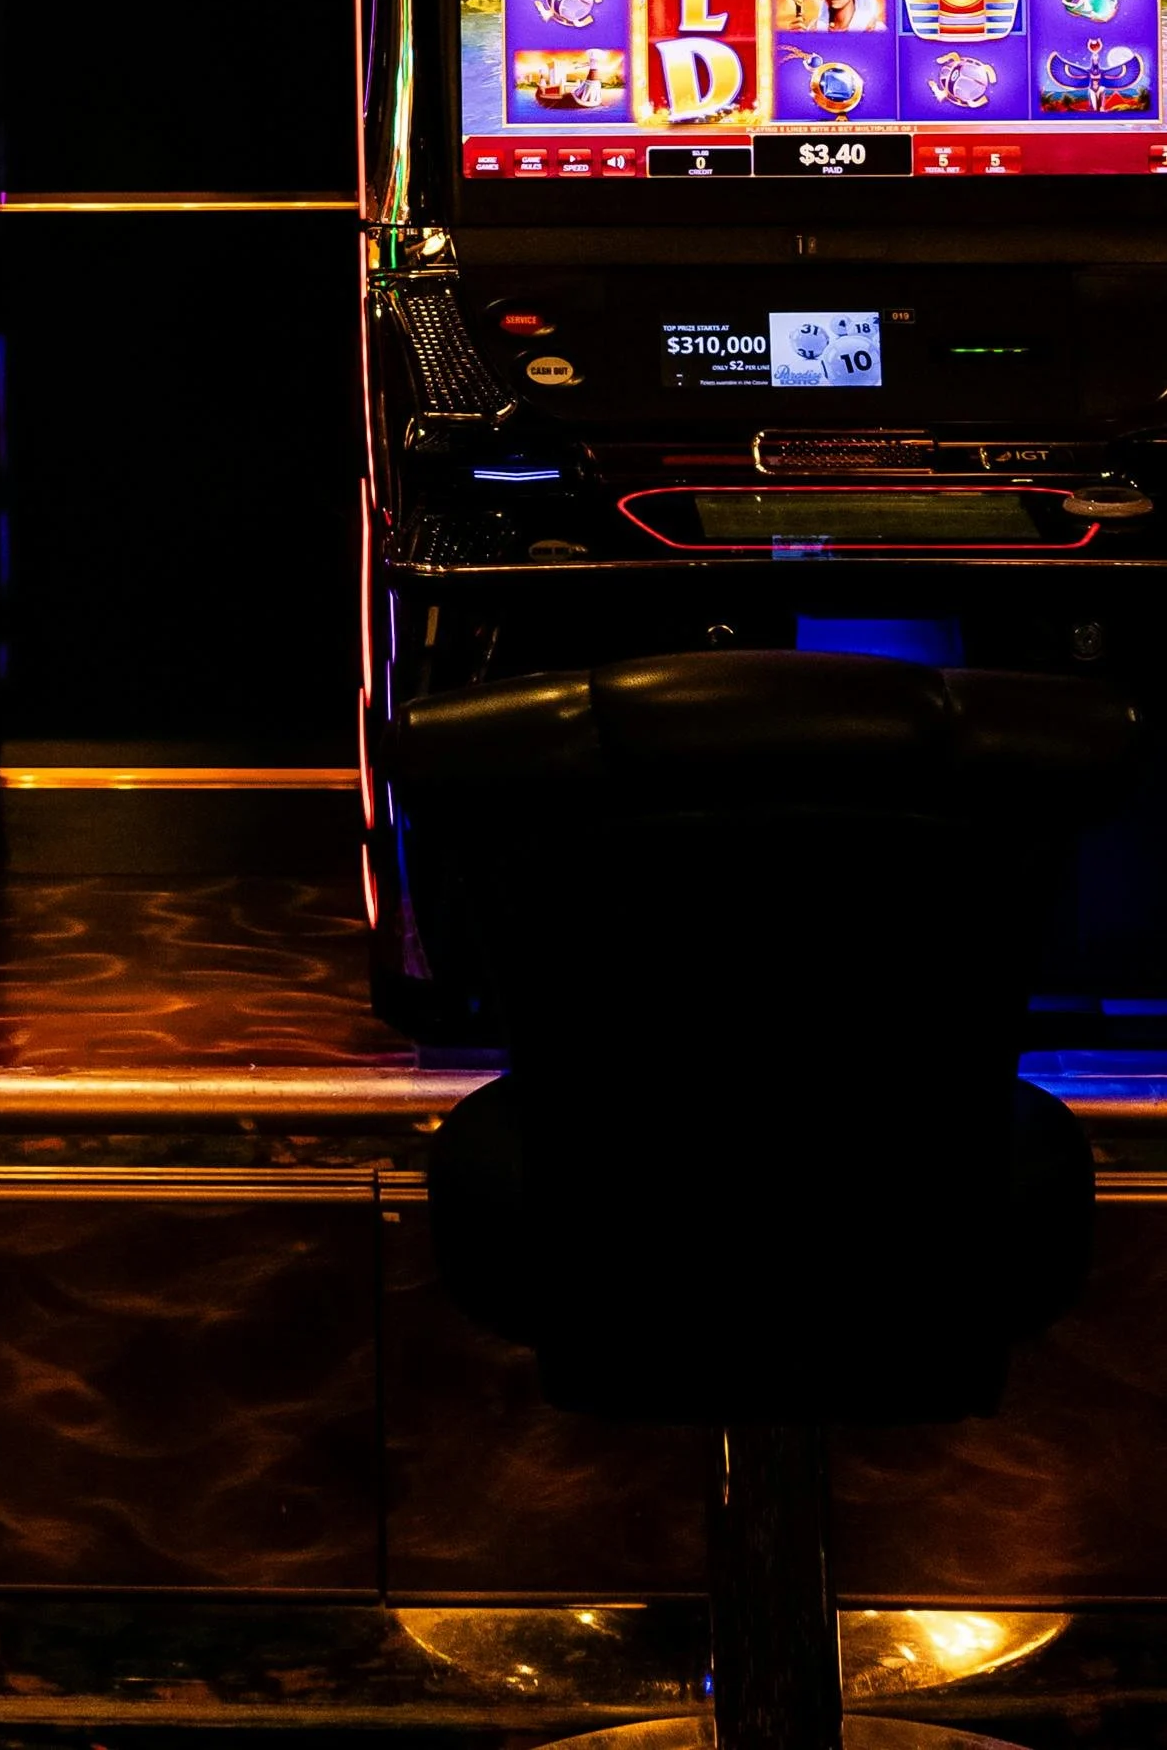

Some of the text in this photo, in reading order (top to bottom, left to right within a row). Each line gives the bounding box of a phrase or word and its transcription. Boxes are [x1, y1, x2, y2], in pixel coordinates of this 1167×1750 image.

[799, 143, 866, 165] $3.40
[695, 157, 705, 169] 0
[938, 154, 949, 167] 5
[990, 154, 1000, 167] 5
[563, 164, 589, 172] SPEED
[822, 166, 843, 174] PAID
[505, 316, 537, 324] SERVICE
[800, 324, 819, 336] 31
[855, 323, 871, 334] 18
[667, 336, 766, 356] $310,000
[729, 360, 744, 371] $2
[840, 350, 872, 374] 10
[531, 367, 568, 375] CASH OUT
[1016, 450, 1049, 461] IGT
